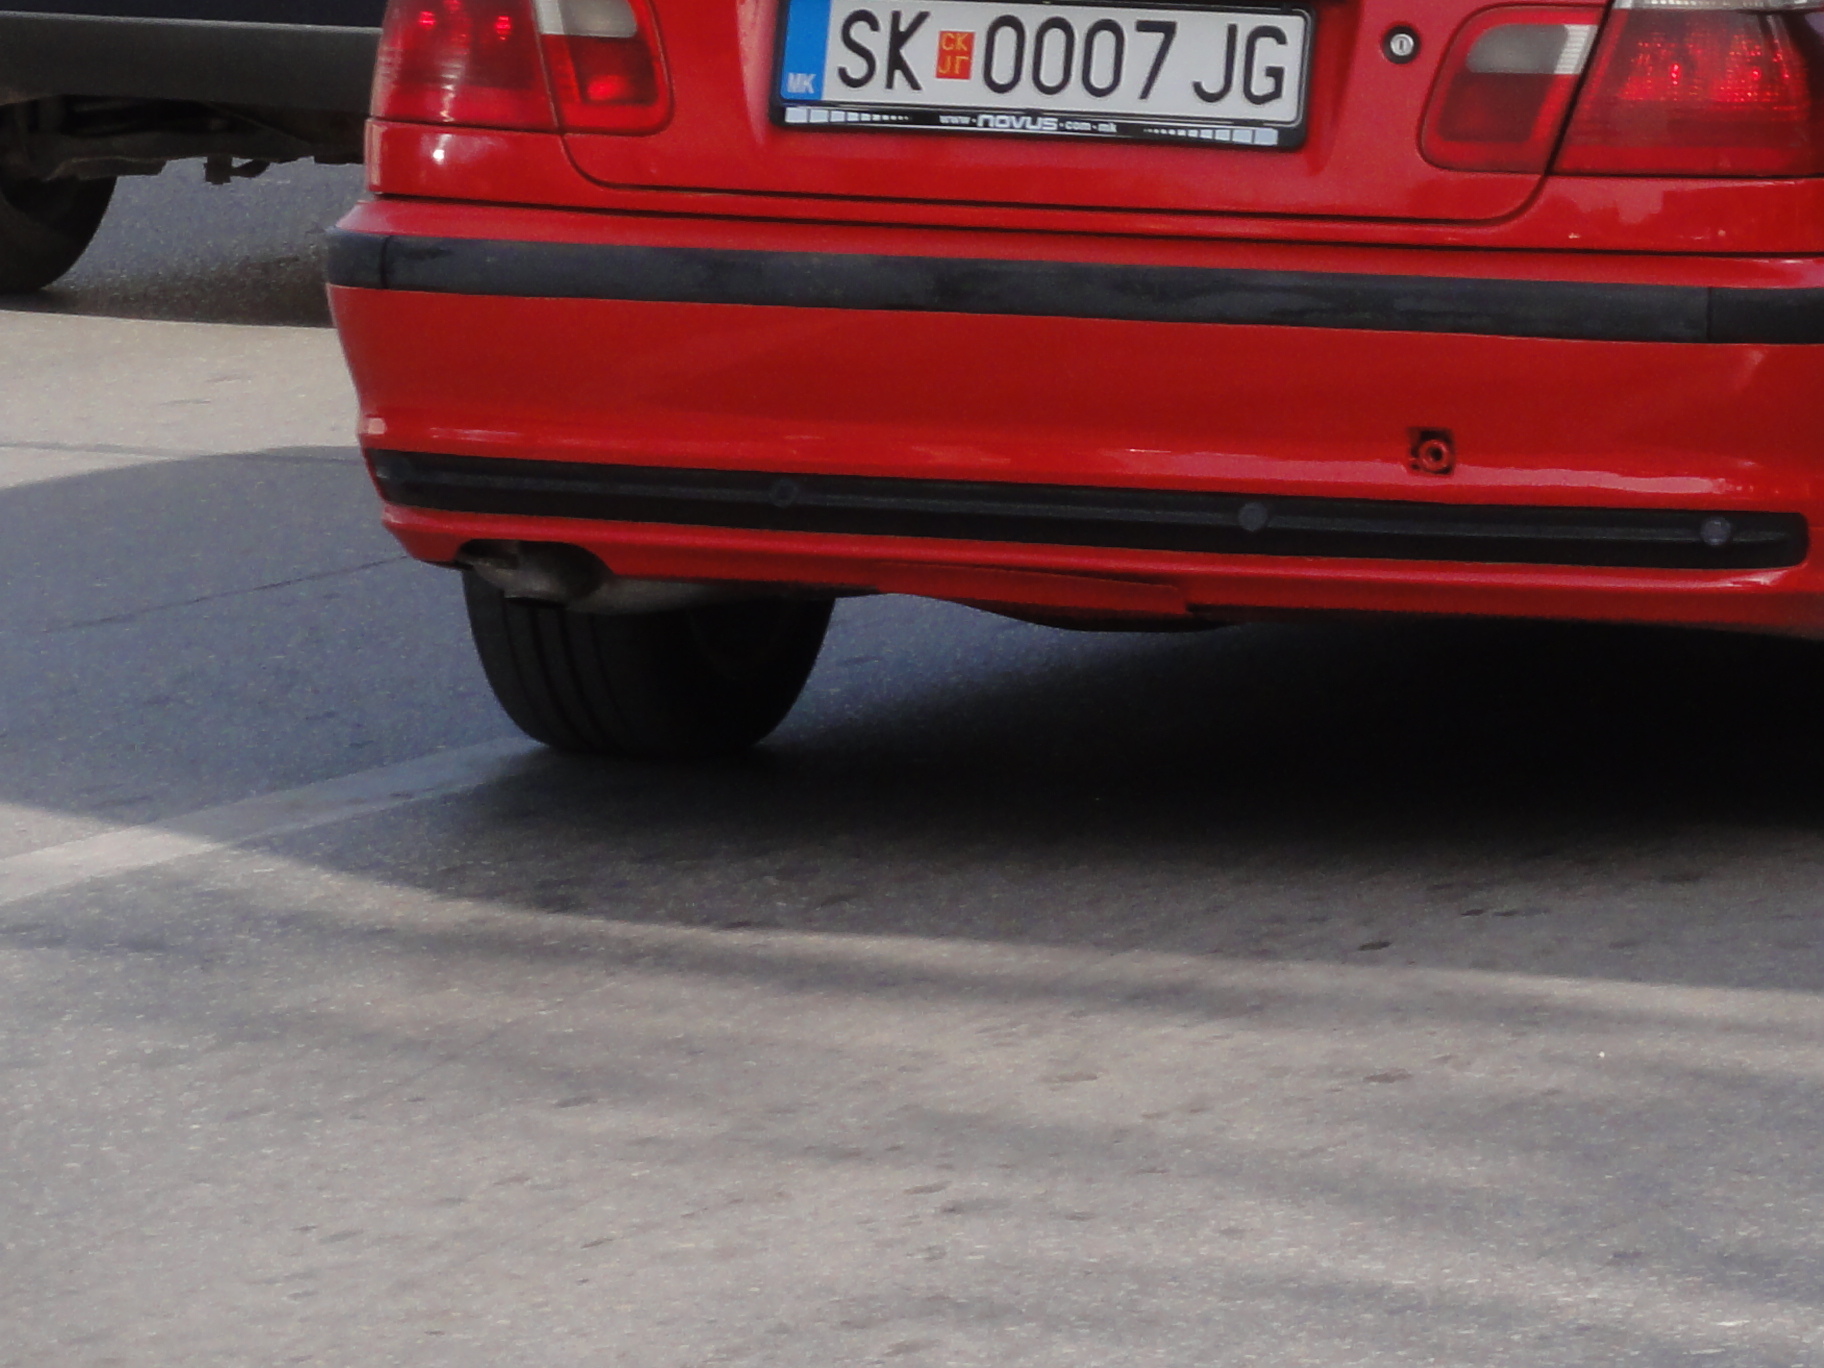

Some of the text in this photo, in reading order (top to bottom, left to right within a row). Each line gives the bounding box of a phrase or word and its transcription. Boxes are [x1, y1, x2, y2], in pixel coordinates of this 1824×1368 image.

[787, 72, 816, 94] MK
[837, 8, 1288, 106] SK 0007 JG
